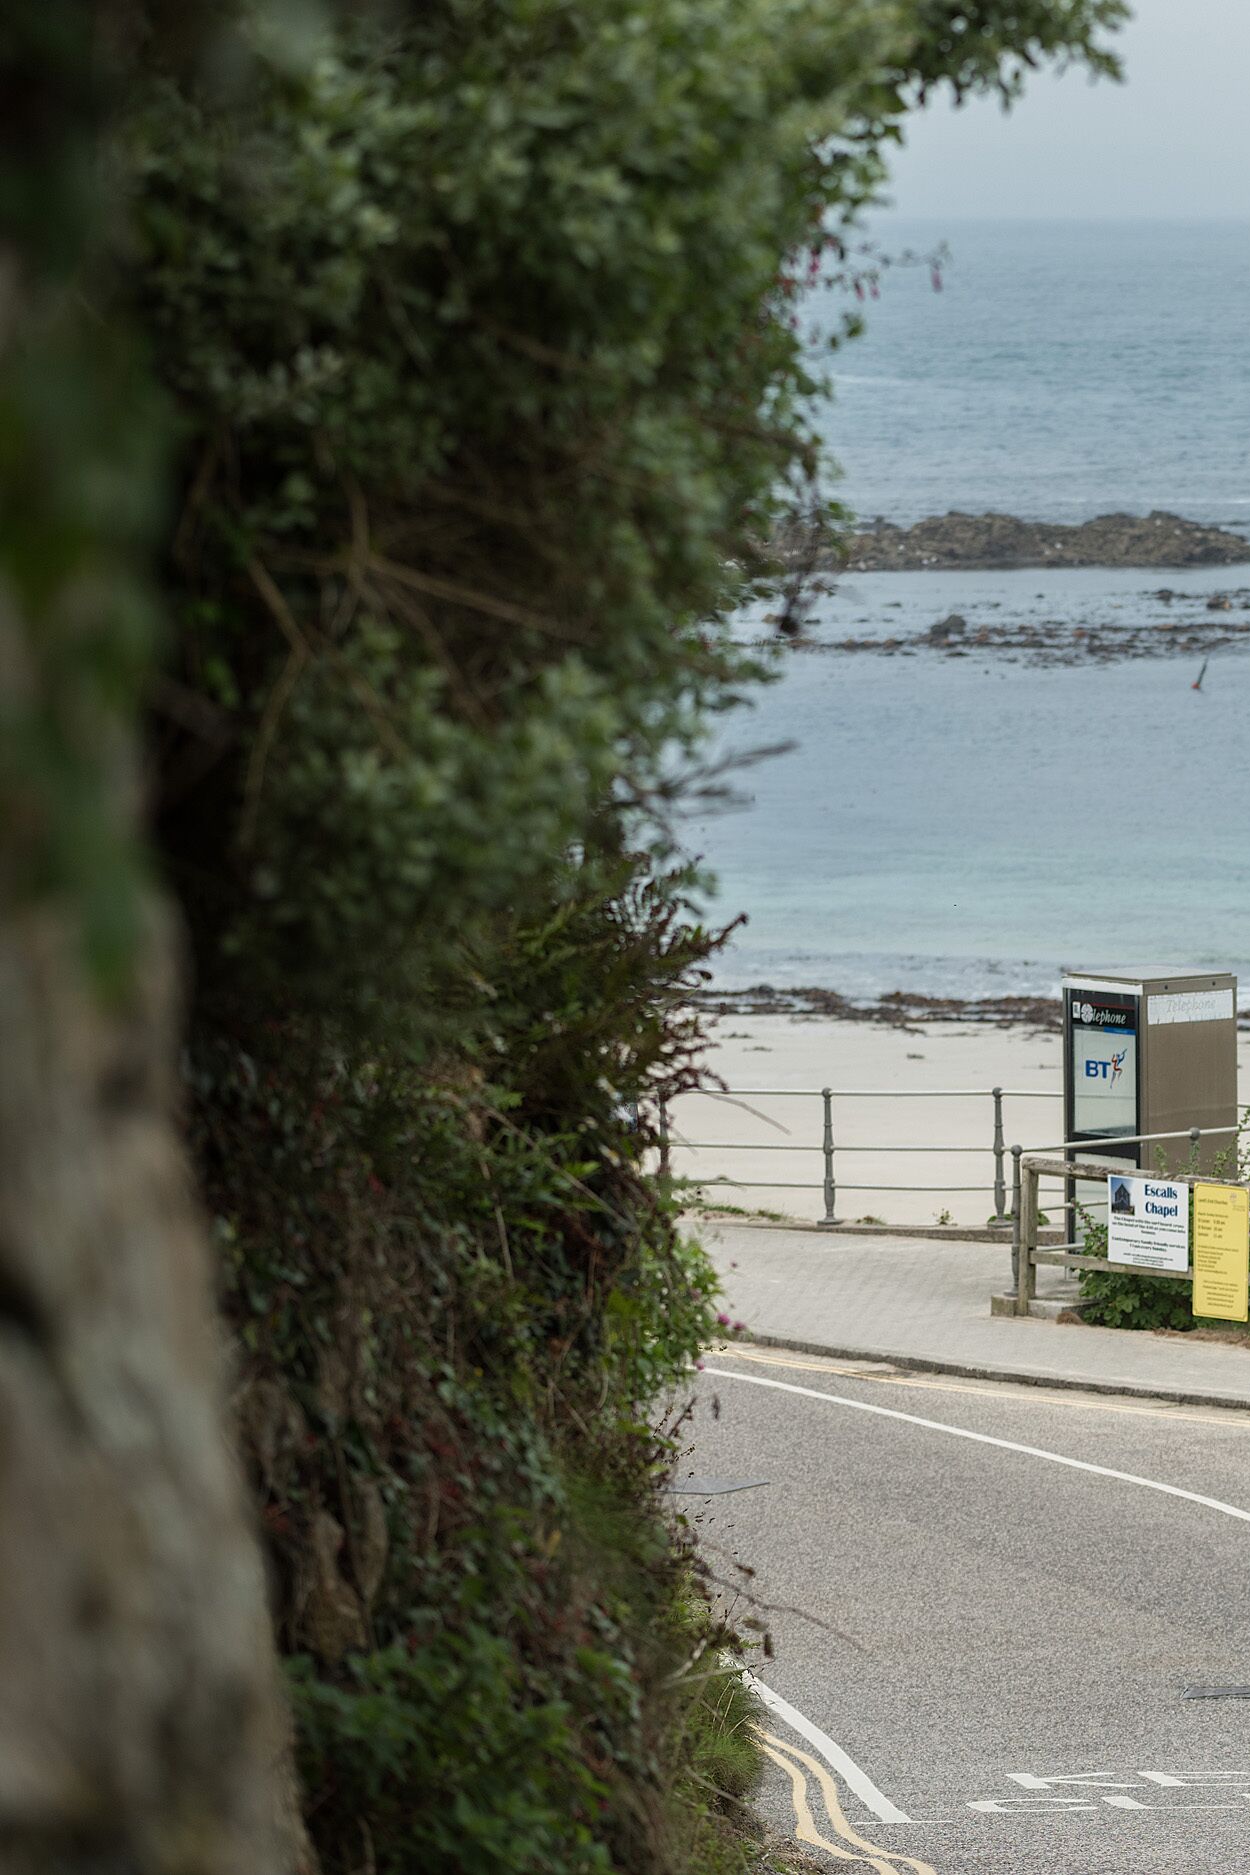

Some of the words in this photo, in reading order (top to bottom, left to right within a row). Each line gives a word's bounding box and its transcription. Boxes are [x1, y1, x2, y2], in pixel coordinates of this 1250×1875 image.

[1082, 1007, 1126, 1025] lephone
[1085, 1060, 1111, 1079] BT
[1144, 1184, 1178, 1199] Escalls
[1145, 1201, 1178, 1218] Chapel
